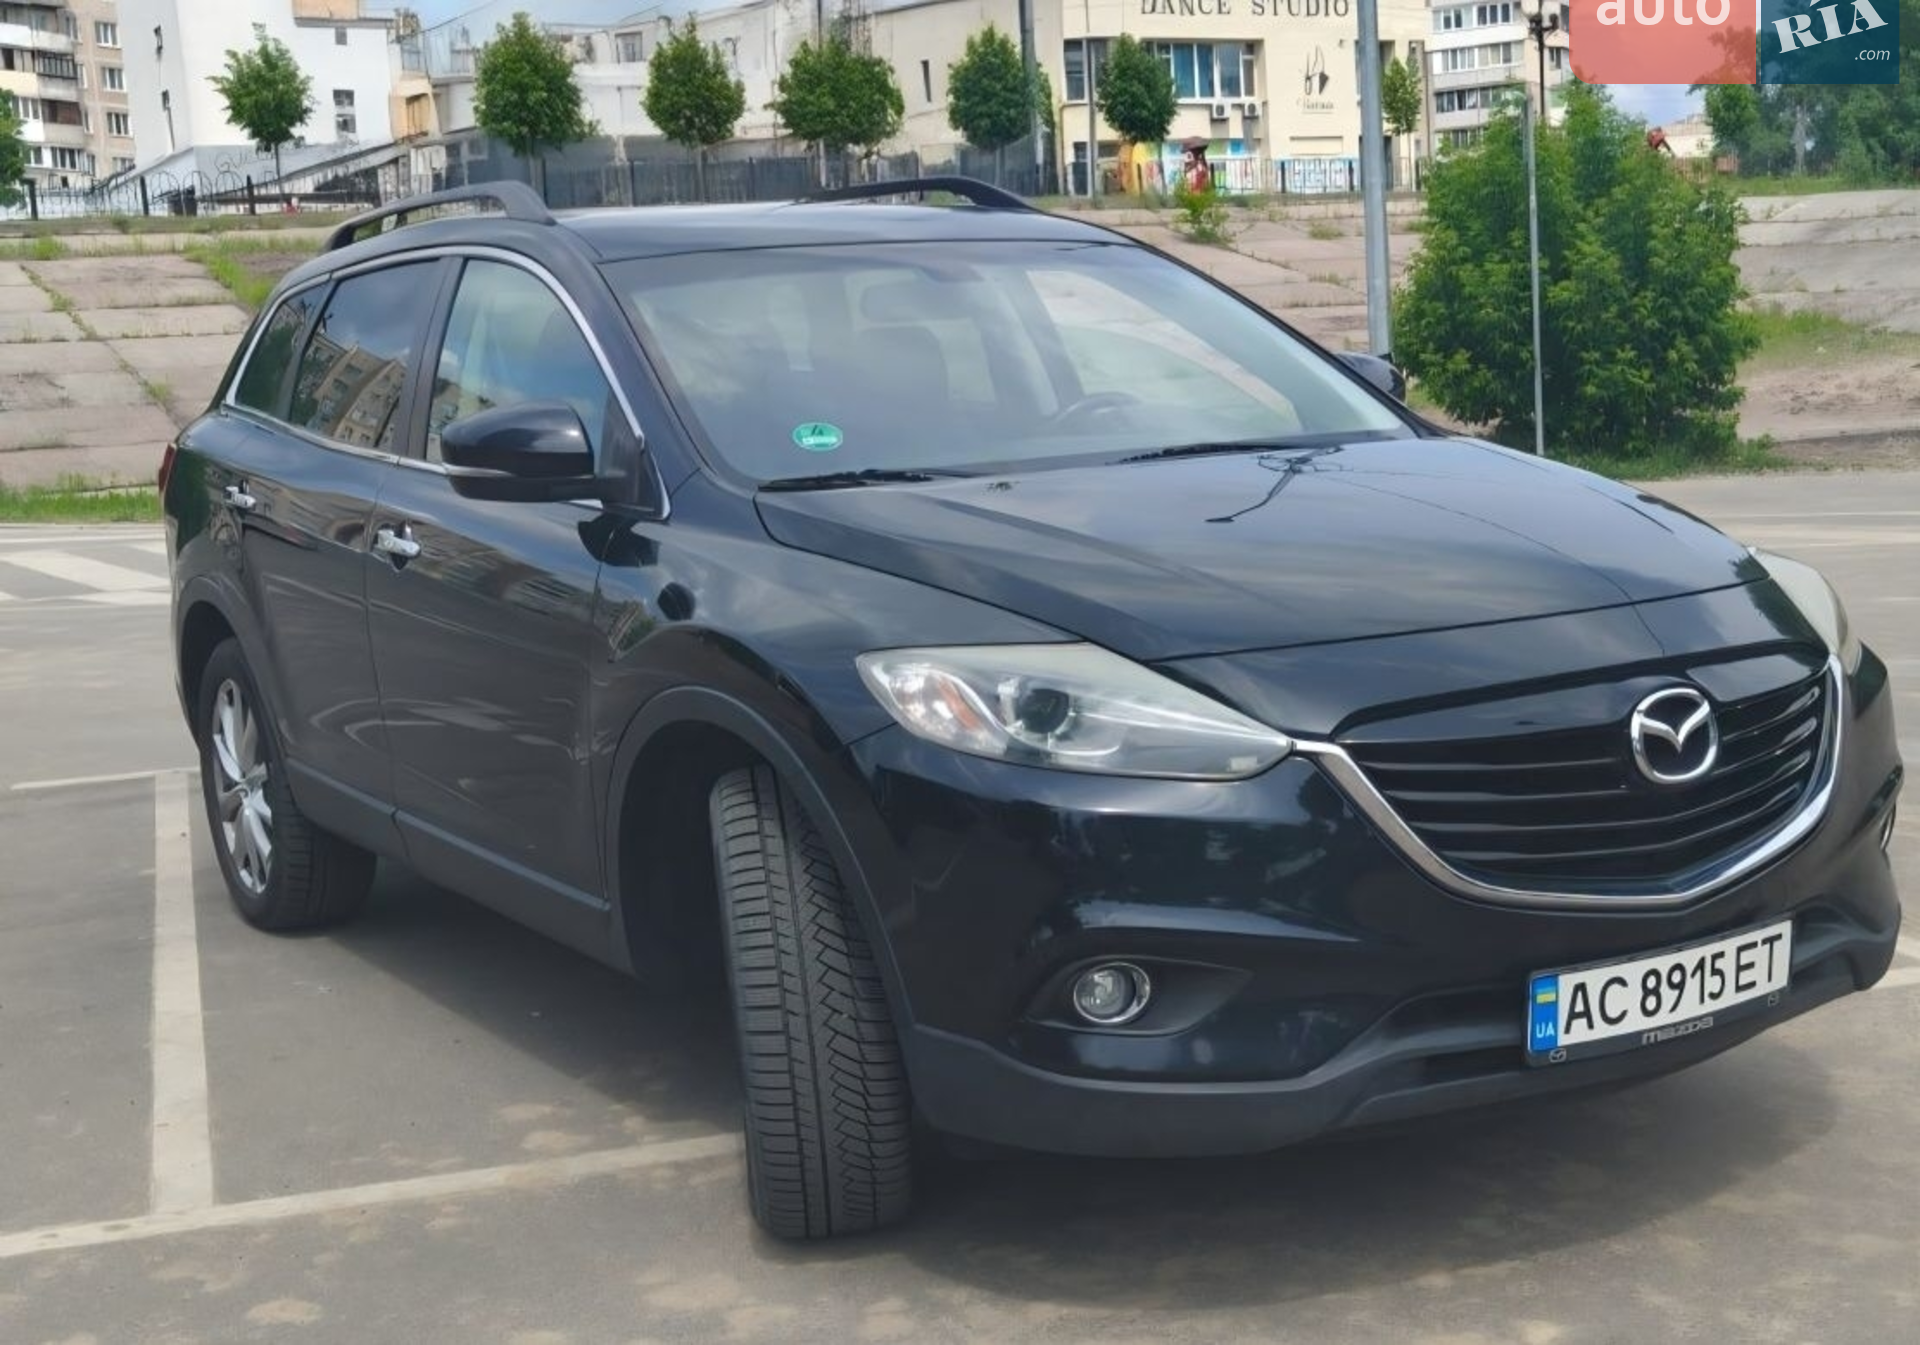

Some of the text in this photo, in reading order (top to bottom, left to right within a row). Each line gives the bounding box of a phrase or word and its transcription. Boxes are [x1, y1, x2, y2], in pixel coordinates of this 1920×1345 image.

[1141, 0, 1350, 17] DANCE STUDIO
[1563, 932, 1783, 1035] AC 8915 ET
[1536, 1021, 1555, 1039] UA
